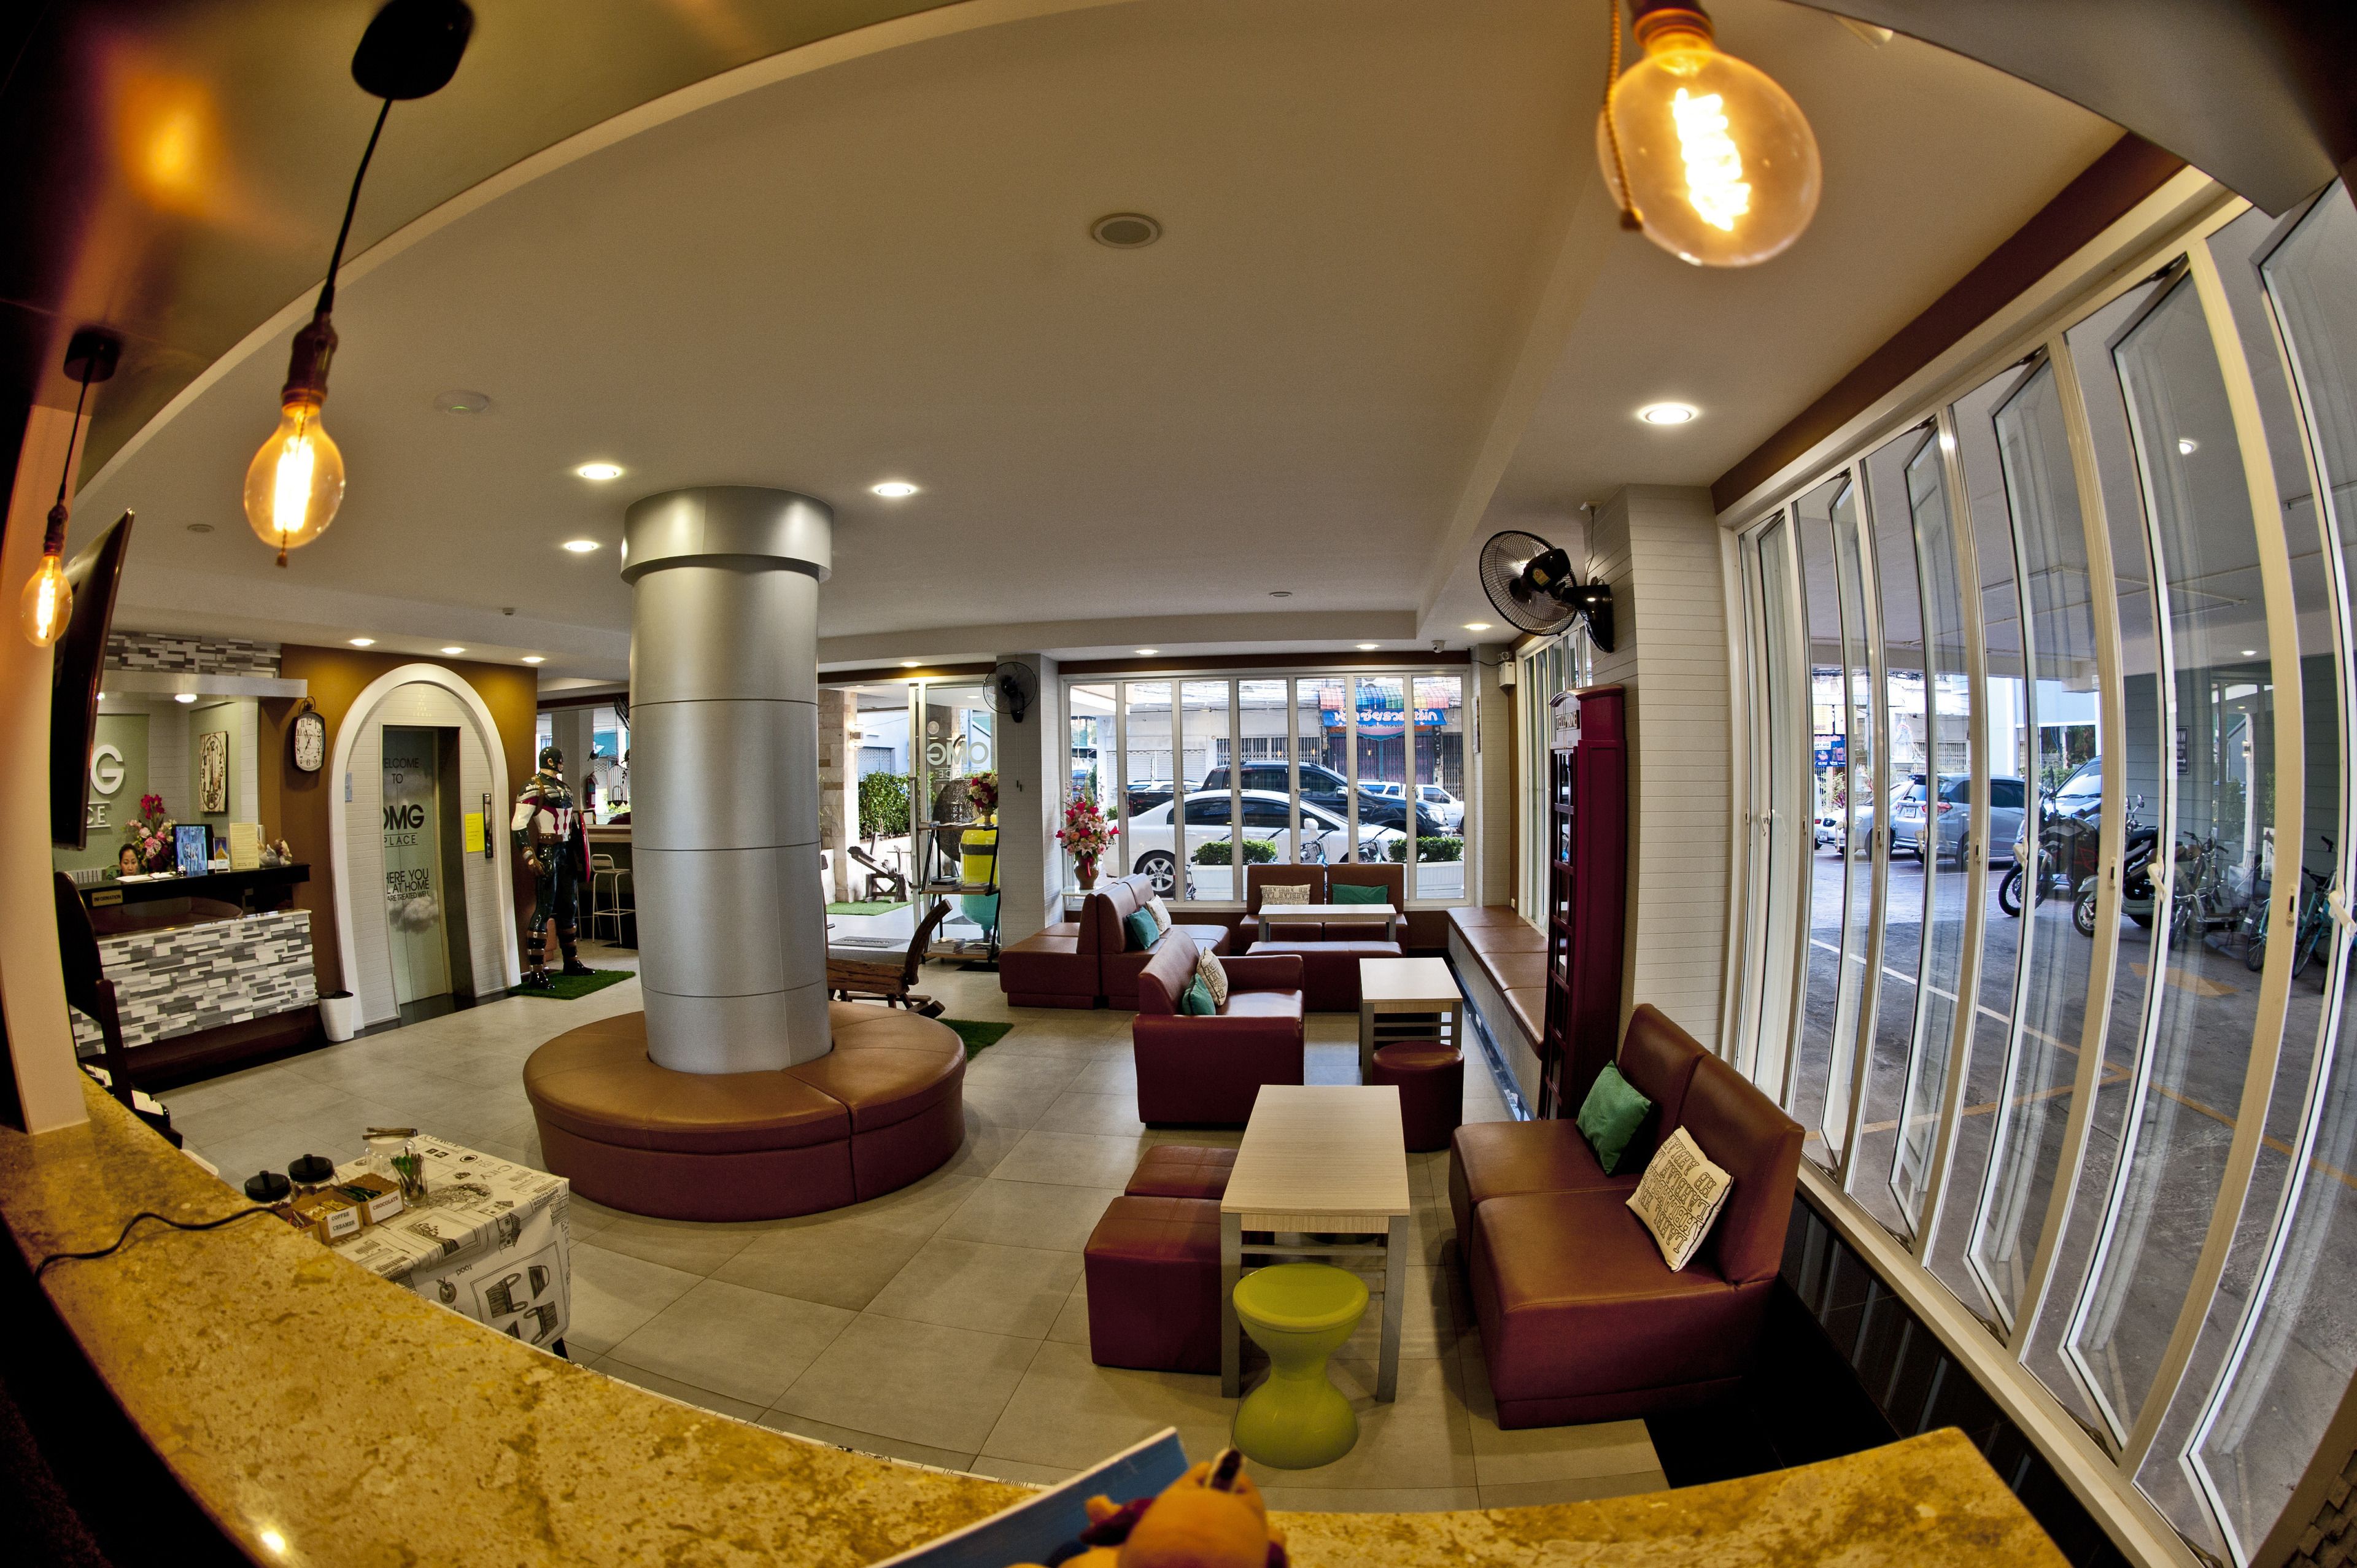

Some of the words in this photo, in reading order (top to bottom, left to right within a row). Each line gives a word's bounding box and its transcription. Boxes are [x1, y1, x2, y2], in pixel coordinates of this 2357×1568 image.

[1557, 712, 1577, 730] TELEPHONE
[383, 757, 419, 768] ELCOME
[392, 773, 403, 784] TO
[408, 868, 428, 881] YOU
[392, 882, 402, 894] AT
[404, 879, 430, 892] HOME
[397, 892, 417, 901] TREATED
[1694, 1172, 1717, 1199] HB
[373, 1195, 399, 1210] CHOCOLATE
[331, 1211, 350, 1221] COFFEE
[333, 1220, 355, 1231] CREAMER
[455, 1264, 473, 1276] food
